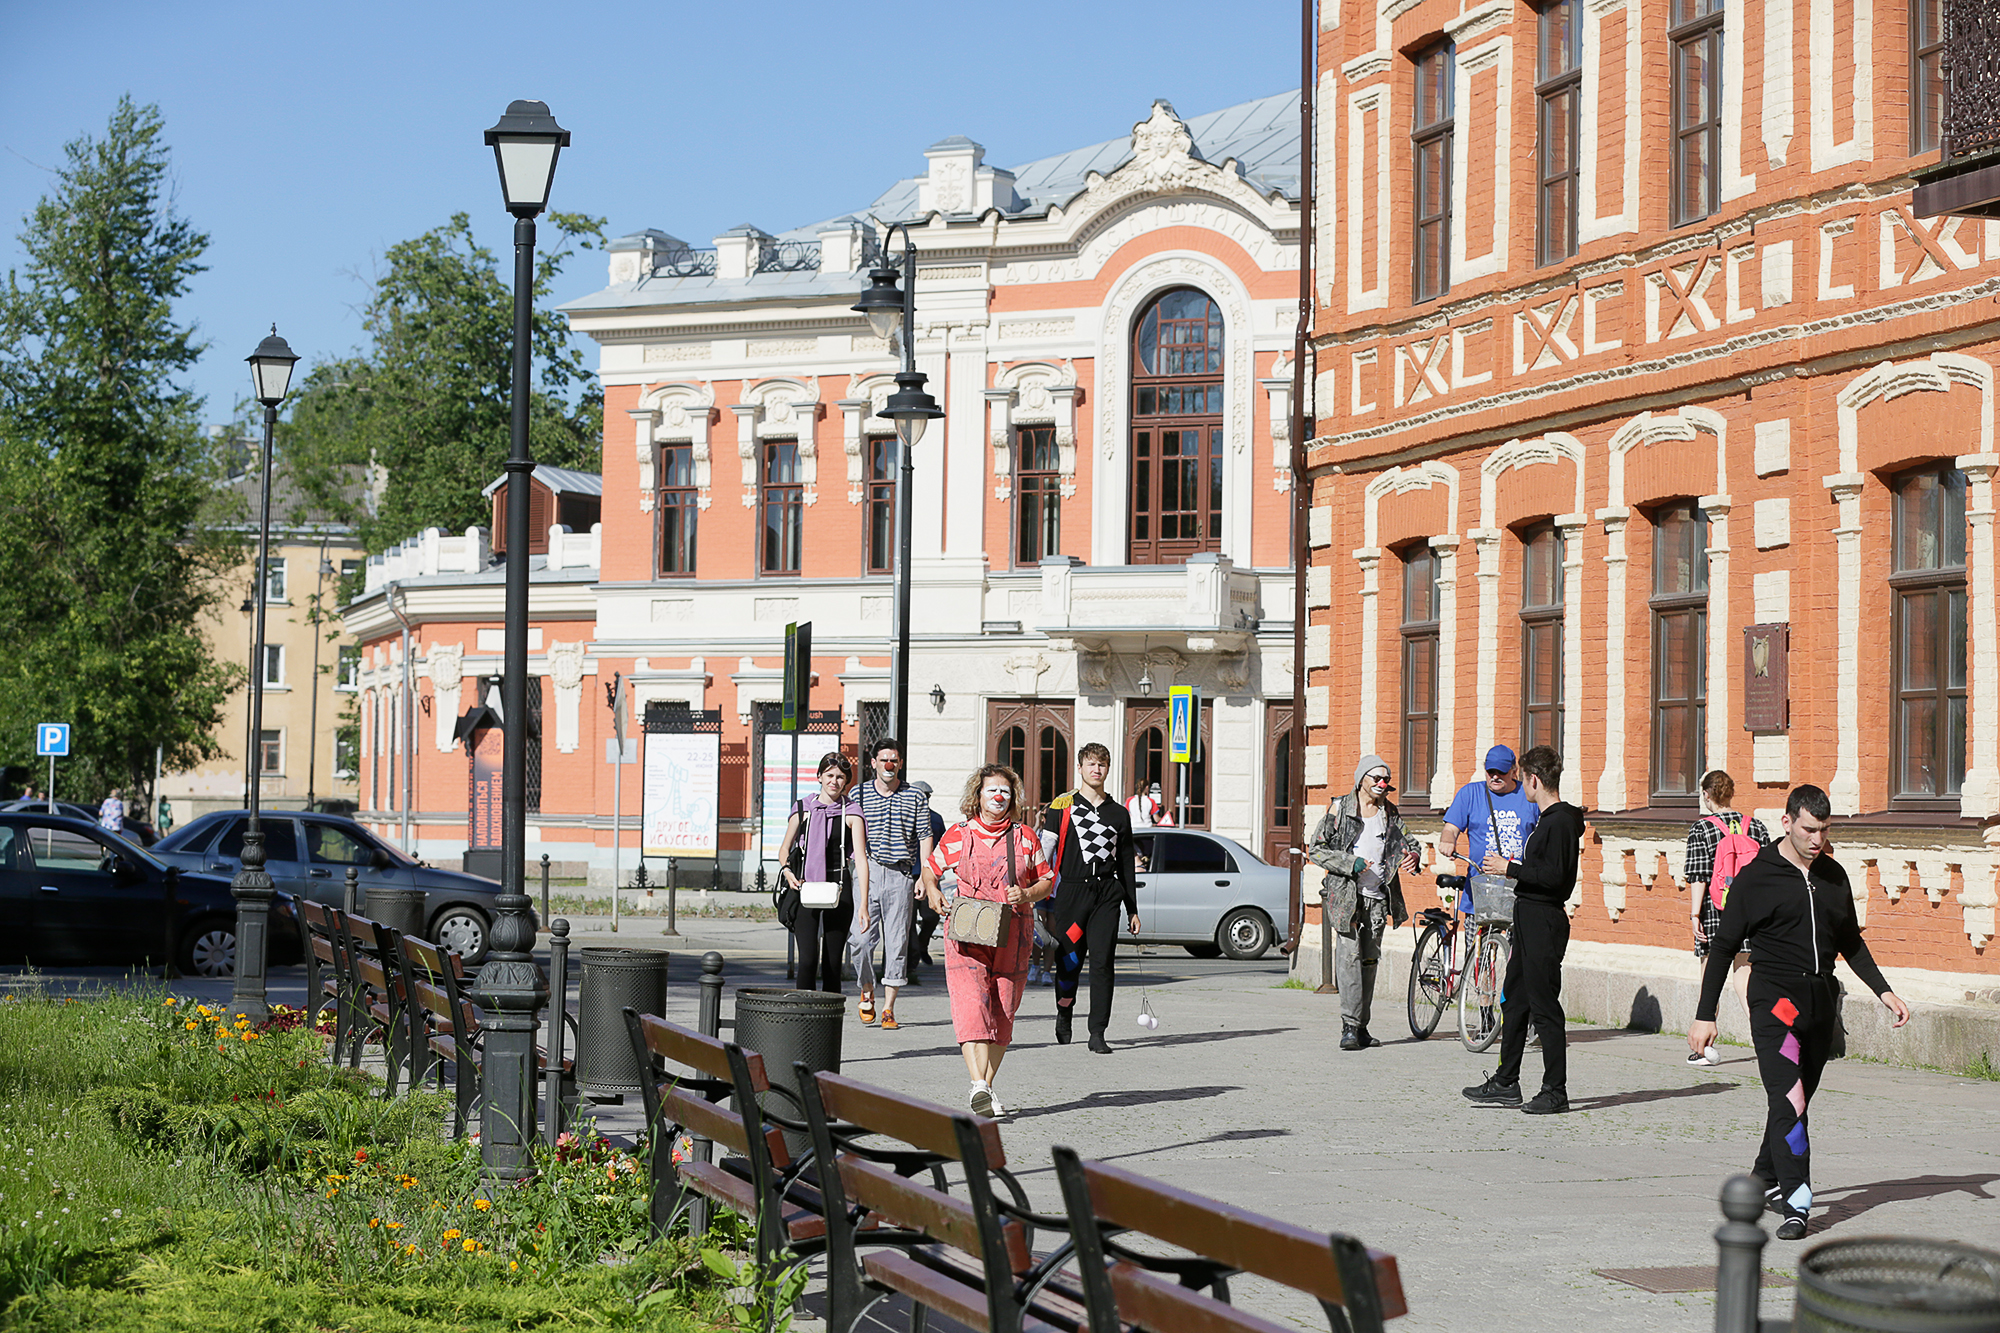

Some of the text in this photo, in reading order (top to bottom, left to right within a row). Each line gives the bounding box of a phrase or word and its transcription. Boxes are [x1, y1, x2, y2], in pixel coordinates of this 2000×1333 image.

[45, 728, 63, 751] P
[687, 752, 714, 762] 22-25
[476, 780, 489, 847] НАПОЛНЯТЬСЯ
[490, 771, 503, 847] ВДОХНОВЕНИЕМ
[655, 821, 690, 833] ДРУГОЕ
[650, 834, 709, 847] ИСКУССТВО
